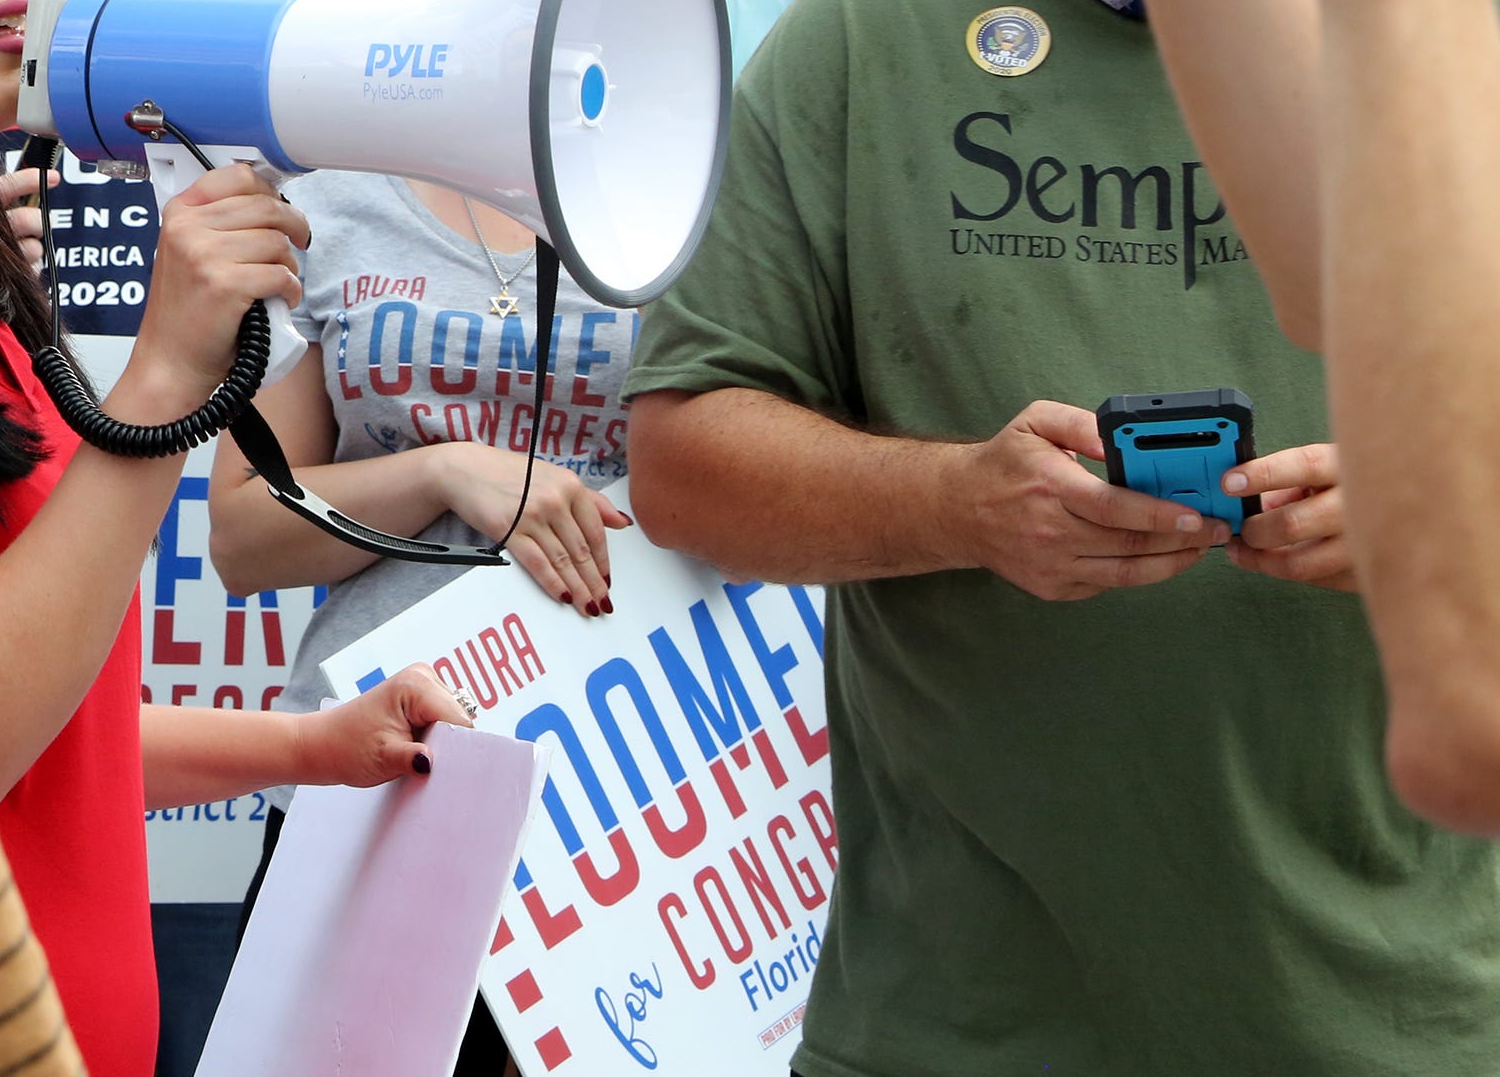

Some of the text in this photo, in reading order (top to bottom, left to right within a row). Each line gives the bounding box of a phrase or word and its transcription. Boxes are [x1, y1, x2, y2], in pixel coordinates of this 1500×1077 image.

[364, 43, 449, 78] PYLE
[985, 53, 1028, 68] VOTED
[363, 82, 444, 103] PyleUSA.com
[49, 205, 150, 229] ENC
[950, 110, 1227, 291] Semp
[46, 245, 145, 268] MERICA
[949, 227, 1067, 261] UNITED
[1074, 234, 1178, 266] STATES
[49, 281, 145, 306] 2020
[343, 275, 427, 308] LAURA
[337, 301, 639, 410] LOOME
[410, 400, 629, 460] CONGRES
[433, 612, 547, 720] AURA
[595, 789, 838, 1071] for CONGR
[739, 919, 823, 1012] Florid
